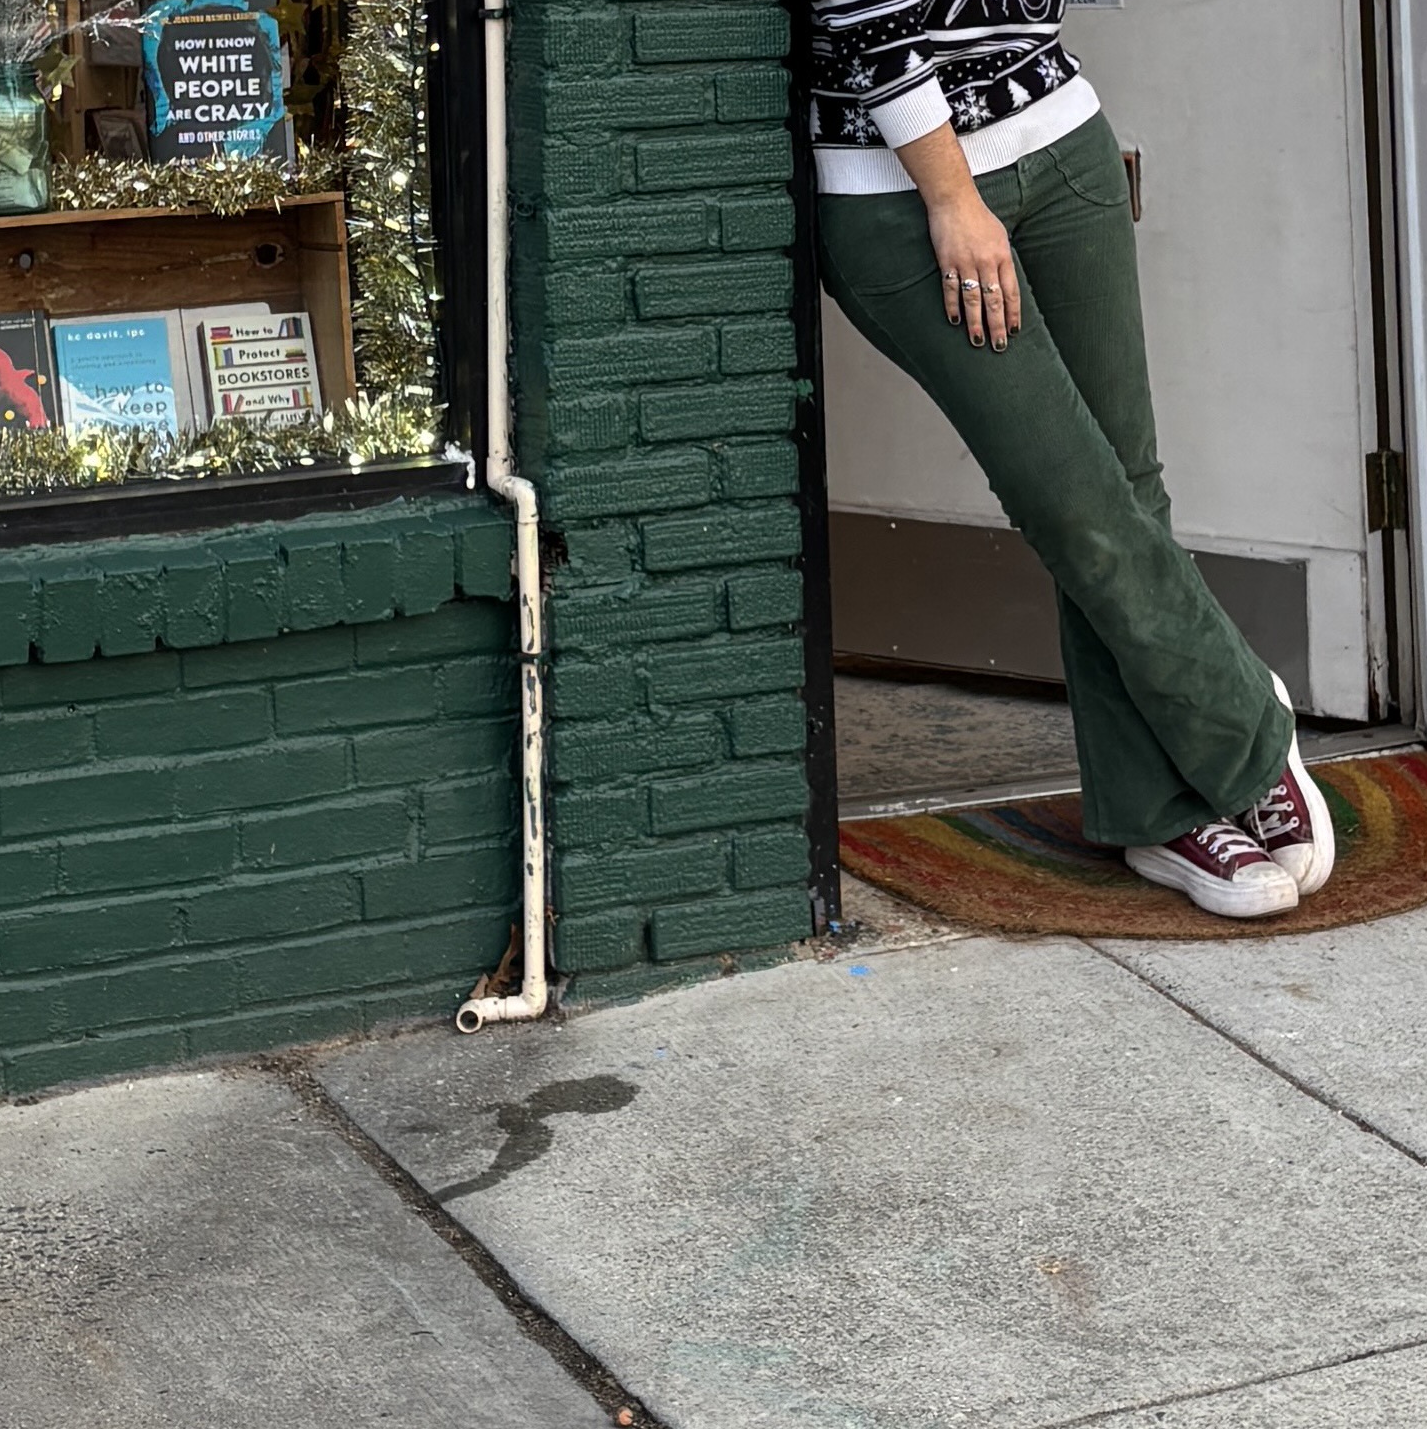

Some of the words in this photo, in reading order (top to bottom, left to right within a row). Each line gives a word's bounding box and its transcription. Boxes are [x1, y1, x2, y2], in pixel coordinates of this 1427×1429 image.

[174, 38, 207, 51] HOW
[208, 38, 213, 49] I
[215, 36, 256, 49] KNOW
[178, 53, 254, 75] WHITE
[173, 77, 261, 99] PEOPLE
[165, 108, 192, 121] ARE
[194, 102, 270, 123] CRAZY
[235, 326, 260, 337] How
[263, 326, 273, 335] to
[238, 348, 280, 360] Protect
[217, 367, 310, 386] BOOKSTORES
[95, 383, 135, 399] how
[144, 380, 165, 394] to
[245, 395, 265, 407] and
[267, 392, 291, 405] Why
[118, 401, 167, 416] keep
